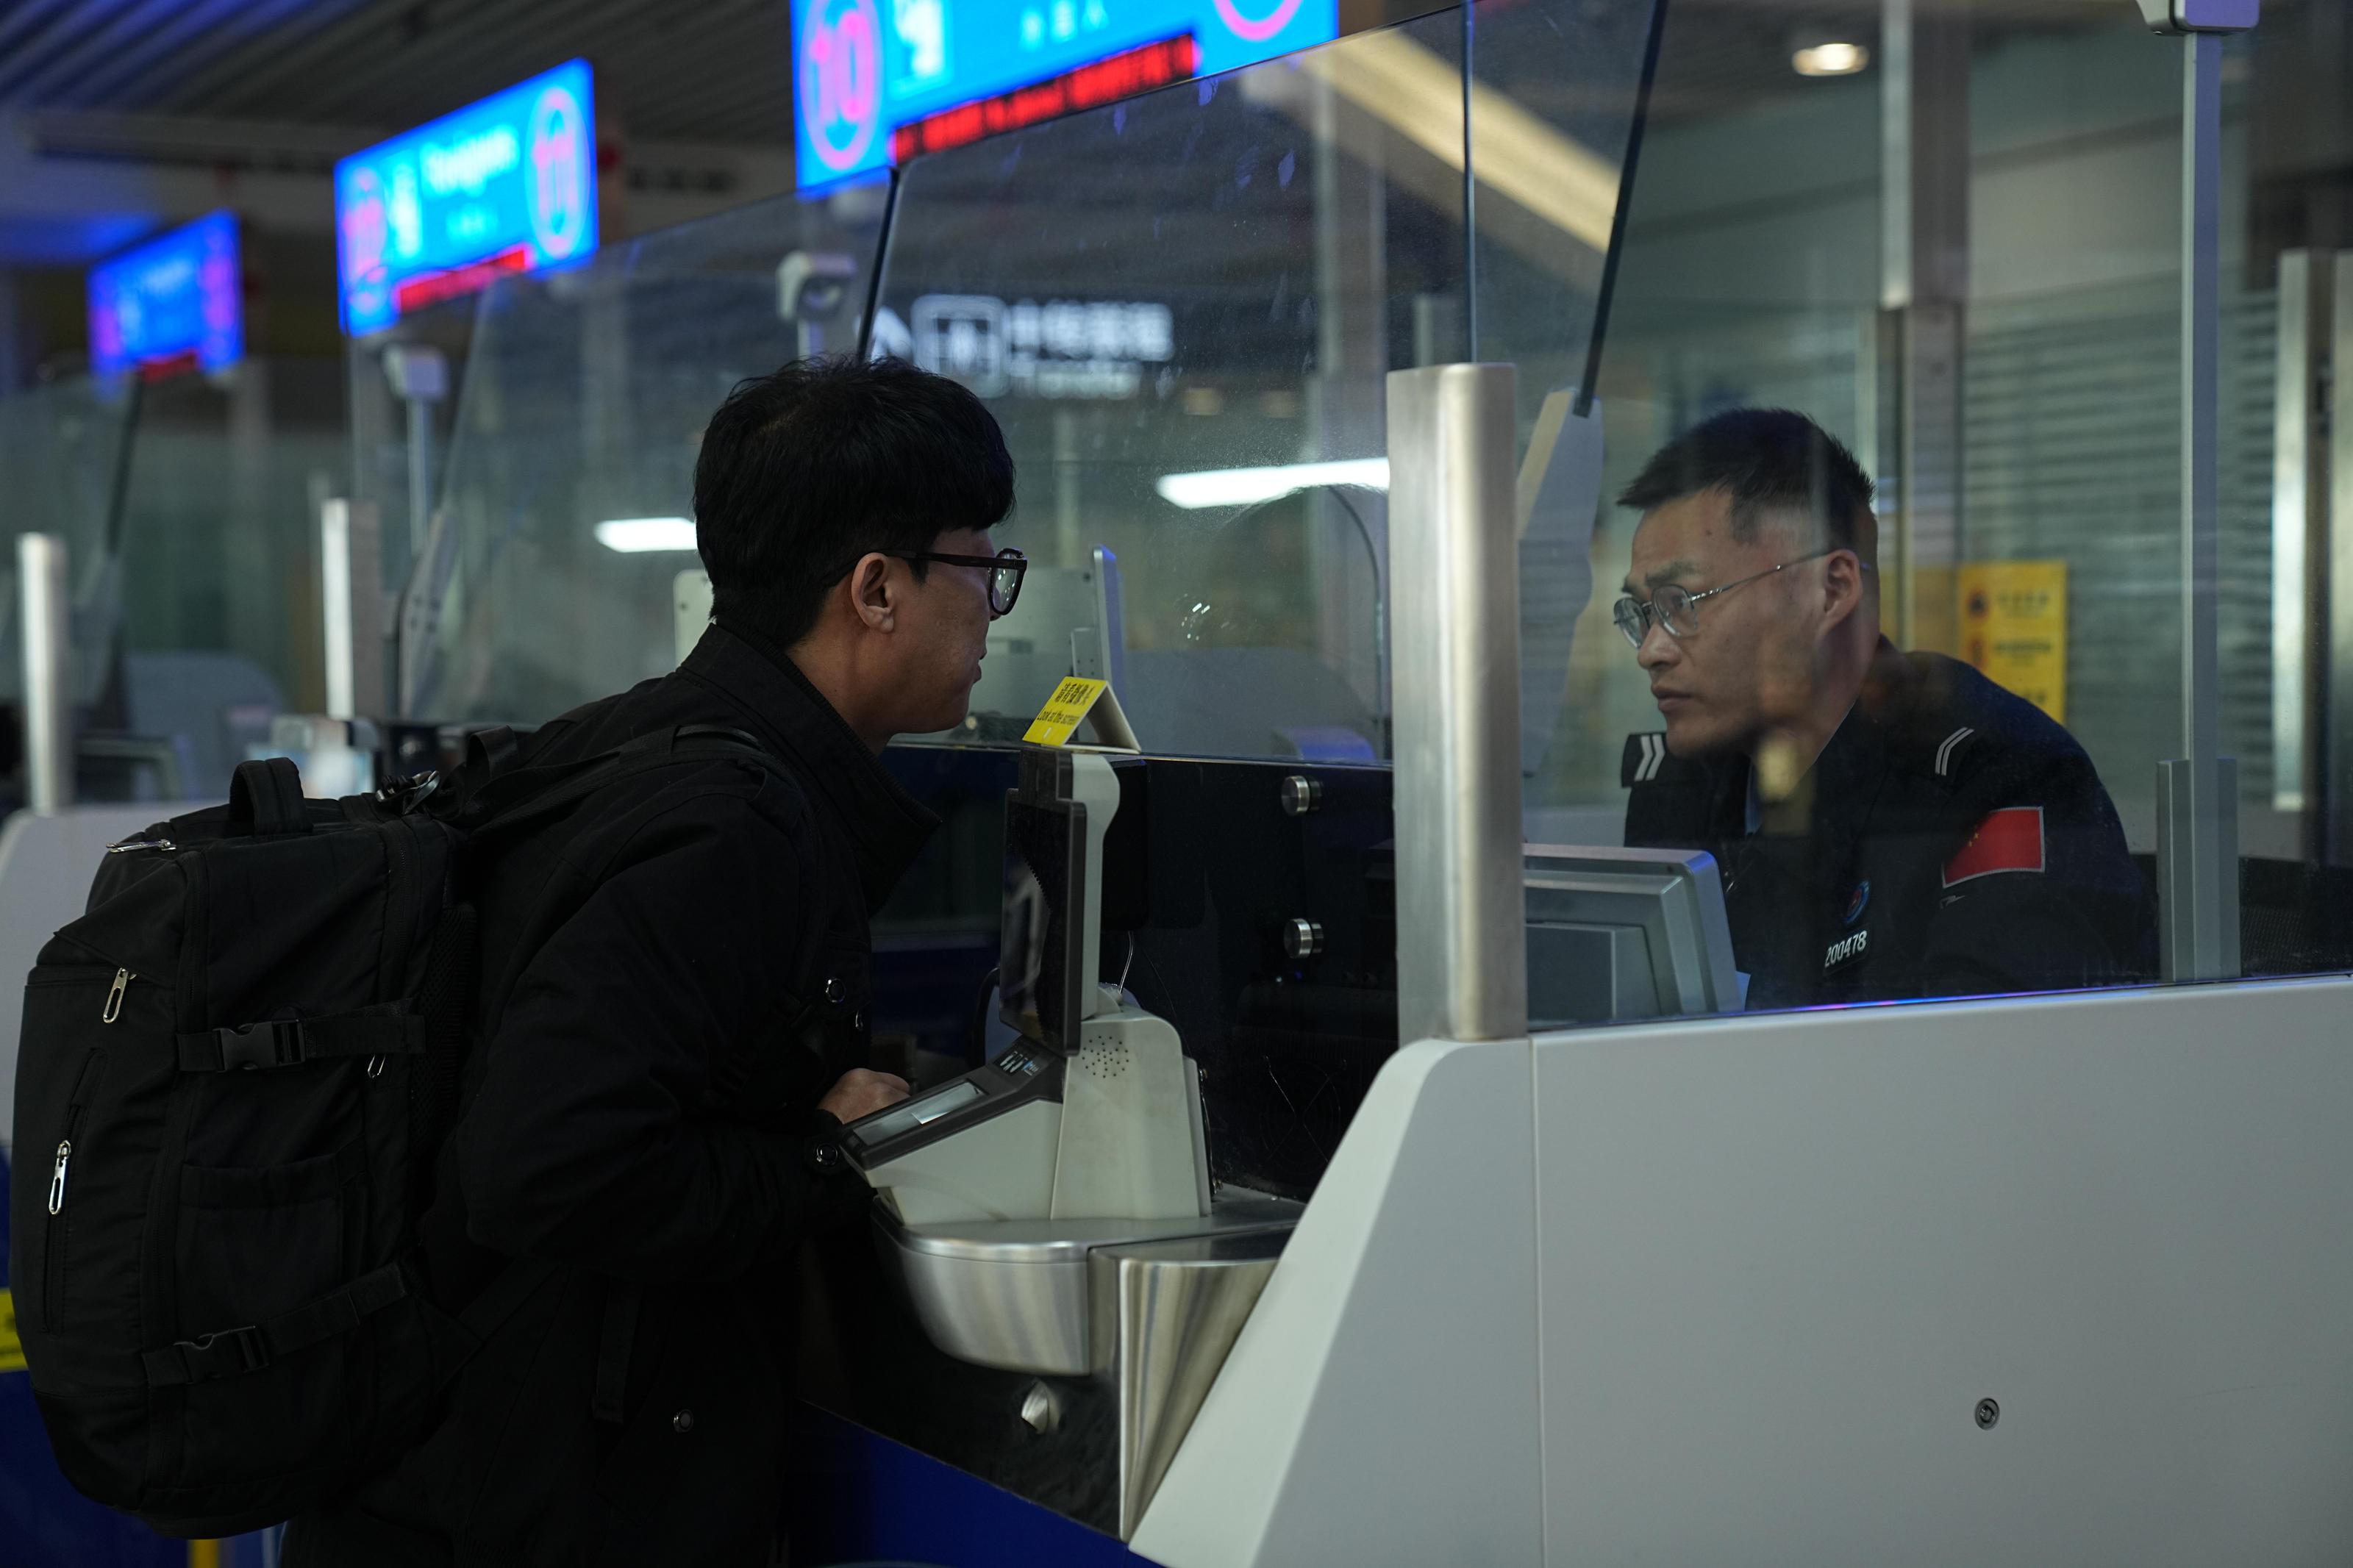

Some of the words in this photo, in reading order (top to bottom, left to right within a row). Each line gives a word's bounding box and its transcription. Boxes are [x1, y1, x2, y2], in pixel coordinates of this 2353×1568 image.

[810, 8, 874, 129] 10
[1037, 707, 1052, 721] Look
[1824, 930, 1868, 968] 200478
